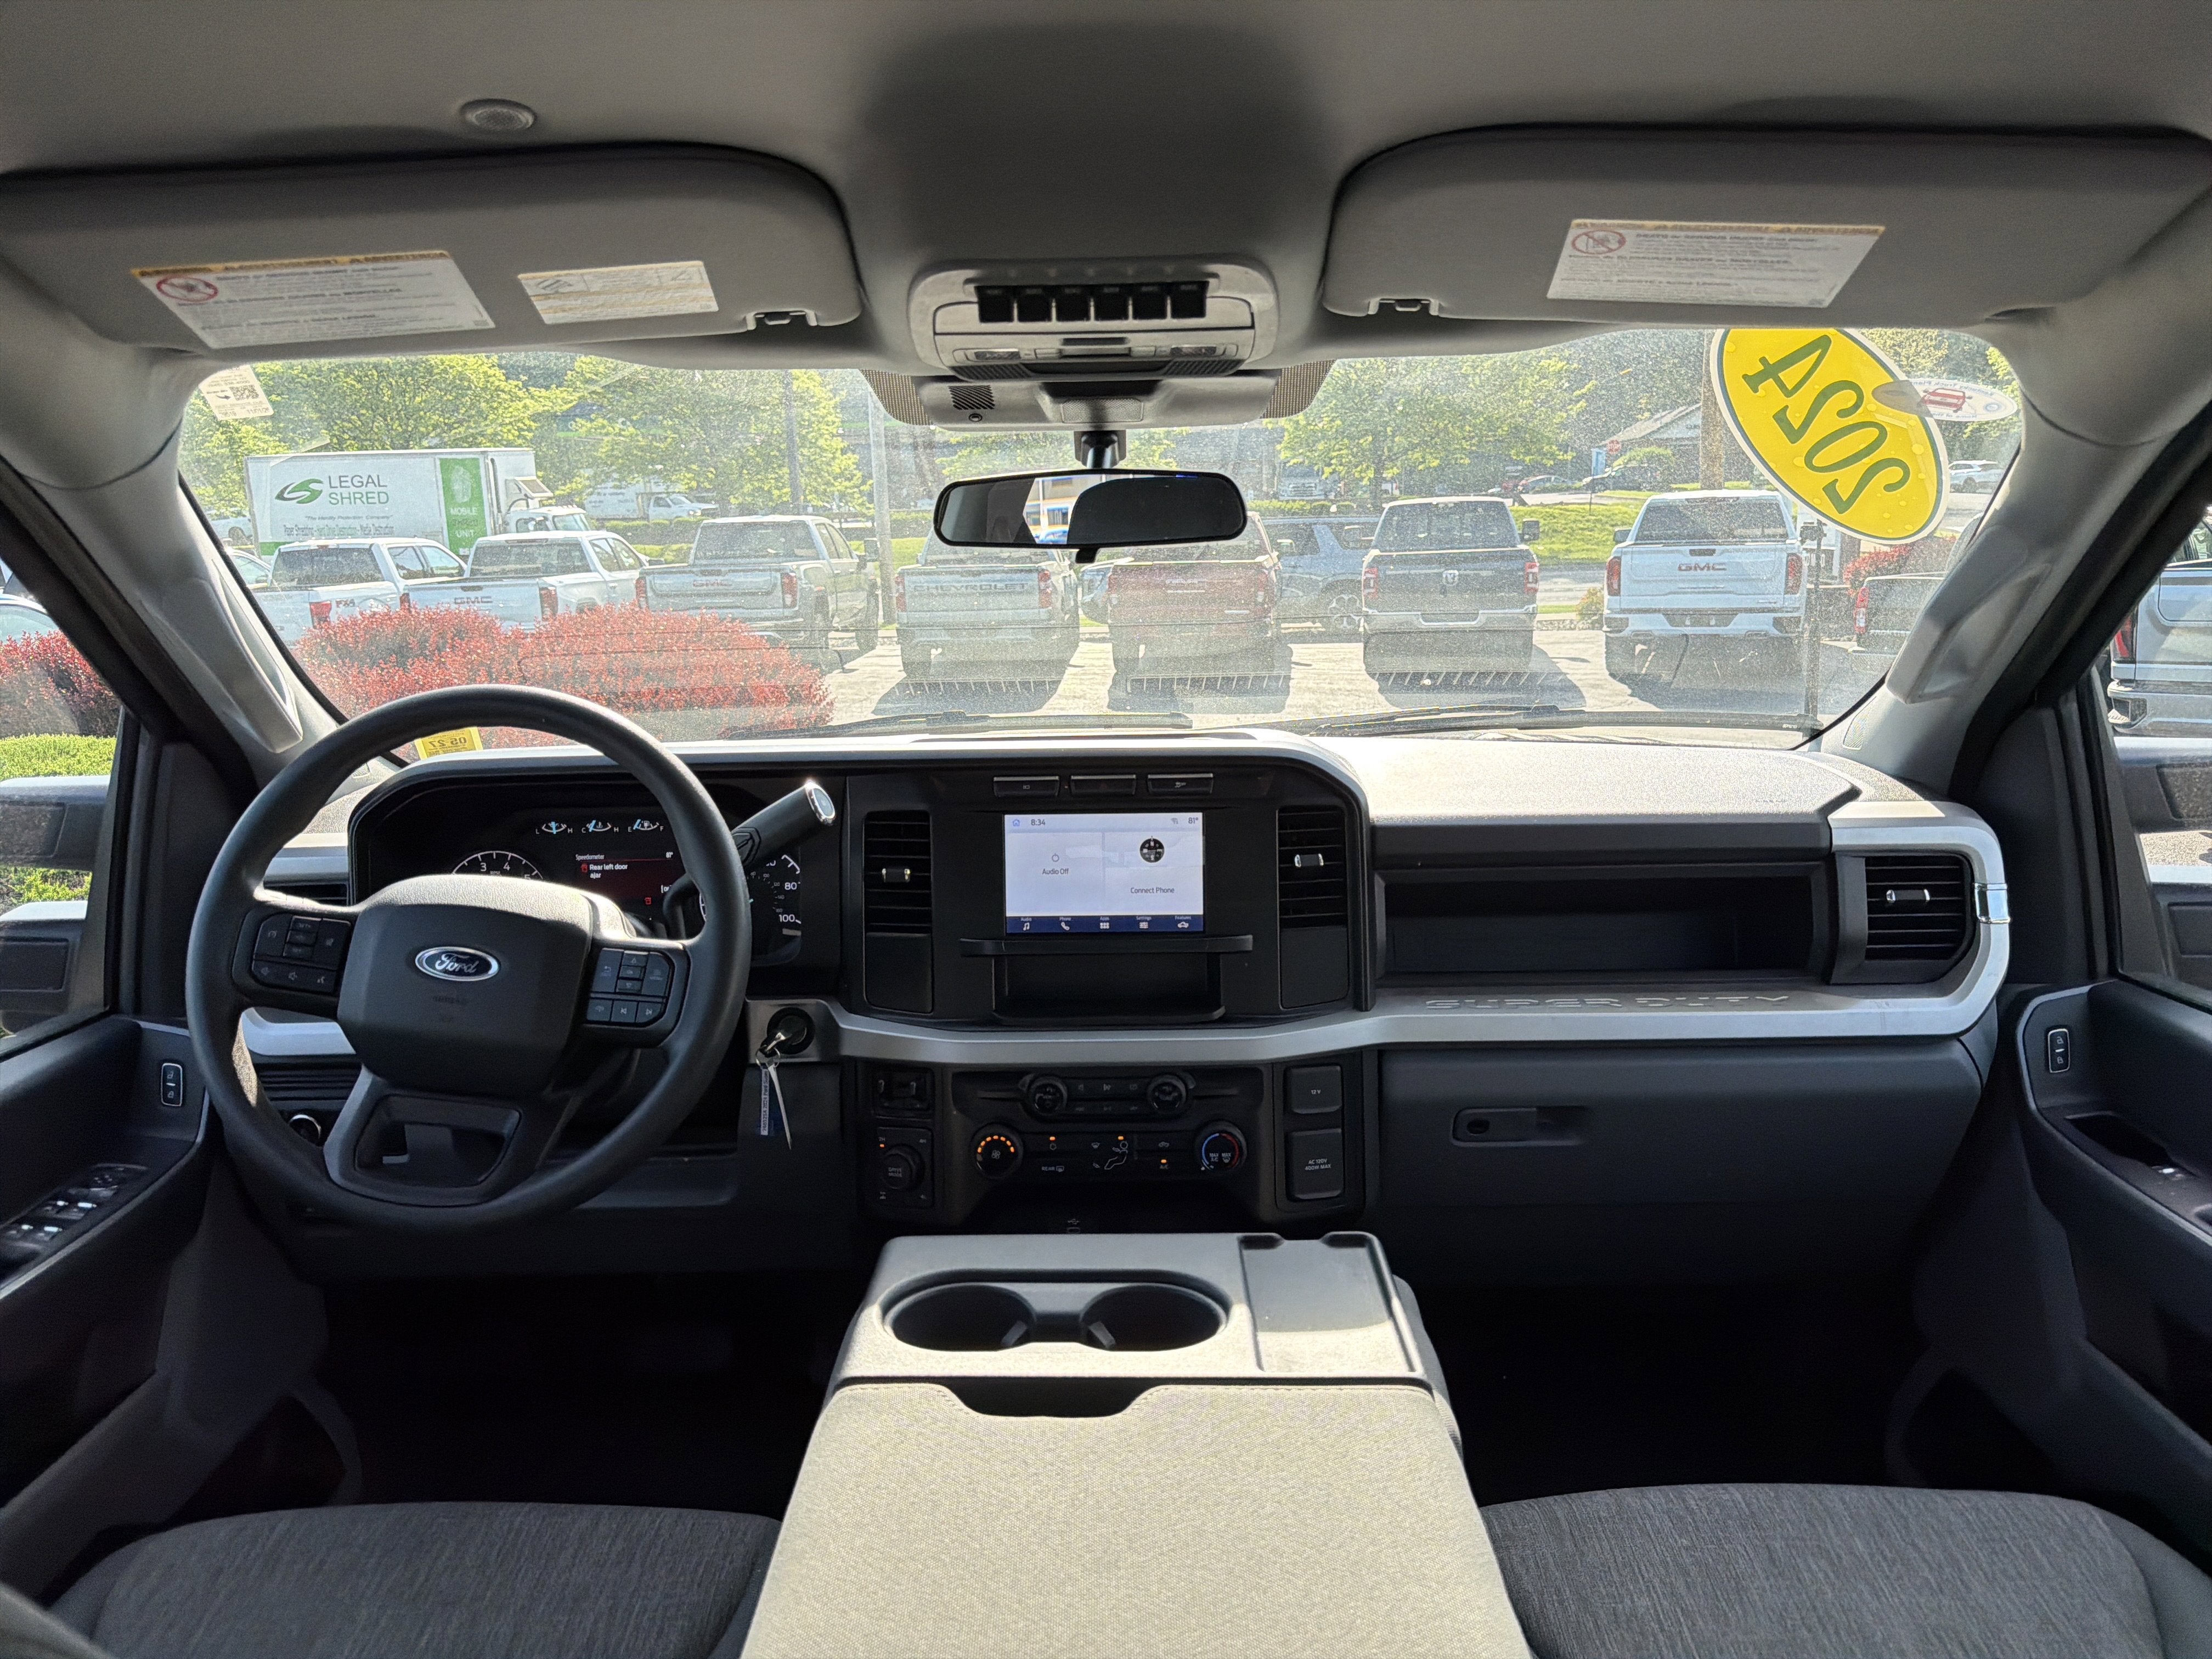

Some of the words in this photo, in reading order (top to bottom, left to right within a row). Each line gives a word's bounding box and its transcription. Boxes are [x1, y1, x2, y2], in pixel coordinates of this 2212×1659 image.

[329, 475, 388, 488] LEGAL
[329, 491, 389, 505] SHRED
[450, 507, 478, 515] MOBILE
[455, 529, 475, 538] UNIT
[1678, 562, 1727, 572] GMC
[913, 583, 1028, 592] CHEVROLET
[454, 596, 493, 605] GMC
[481, 862, 487, 872] 3
[503, 862, 511, 871] 4
[785, 882, 797, 890] 80
[779, 914, 795, 922] 100
[435, 953, 479, 973] Ford
[1426, 998, 1623, 1009] SUPER
